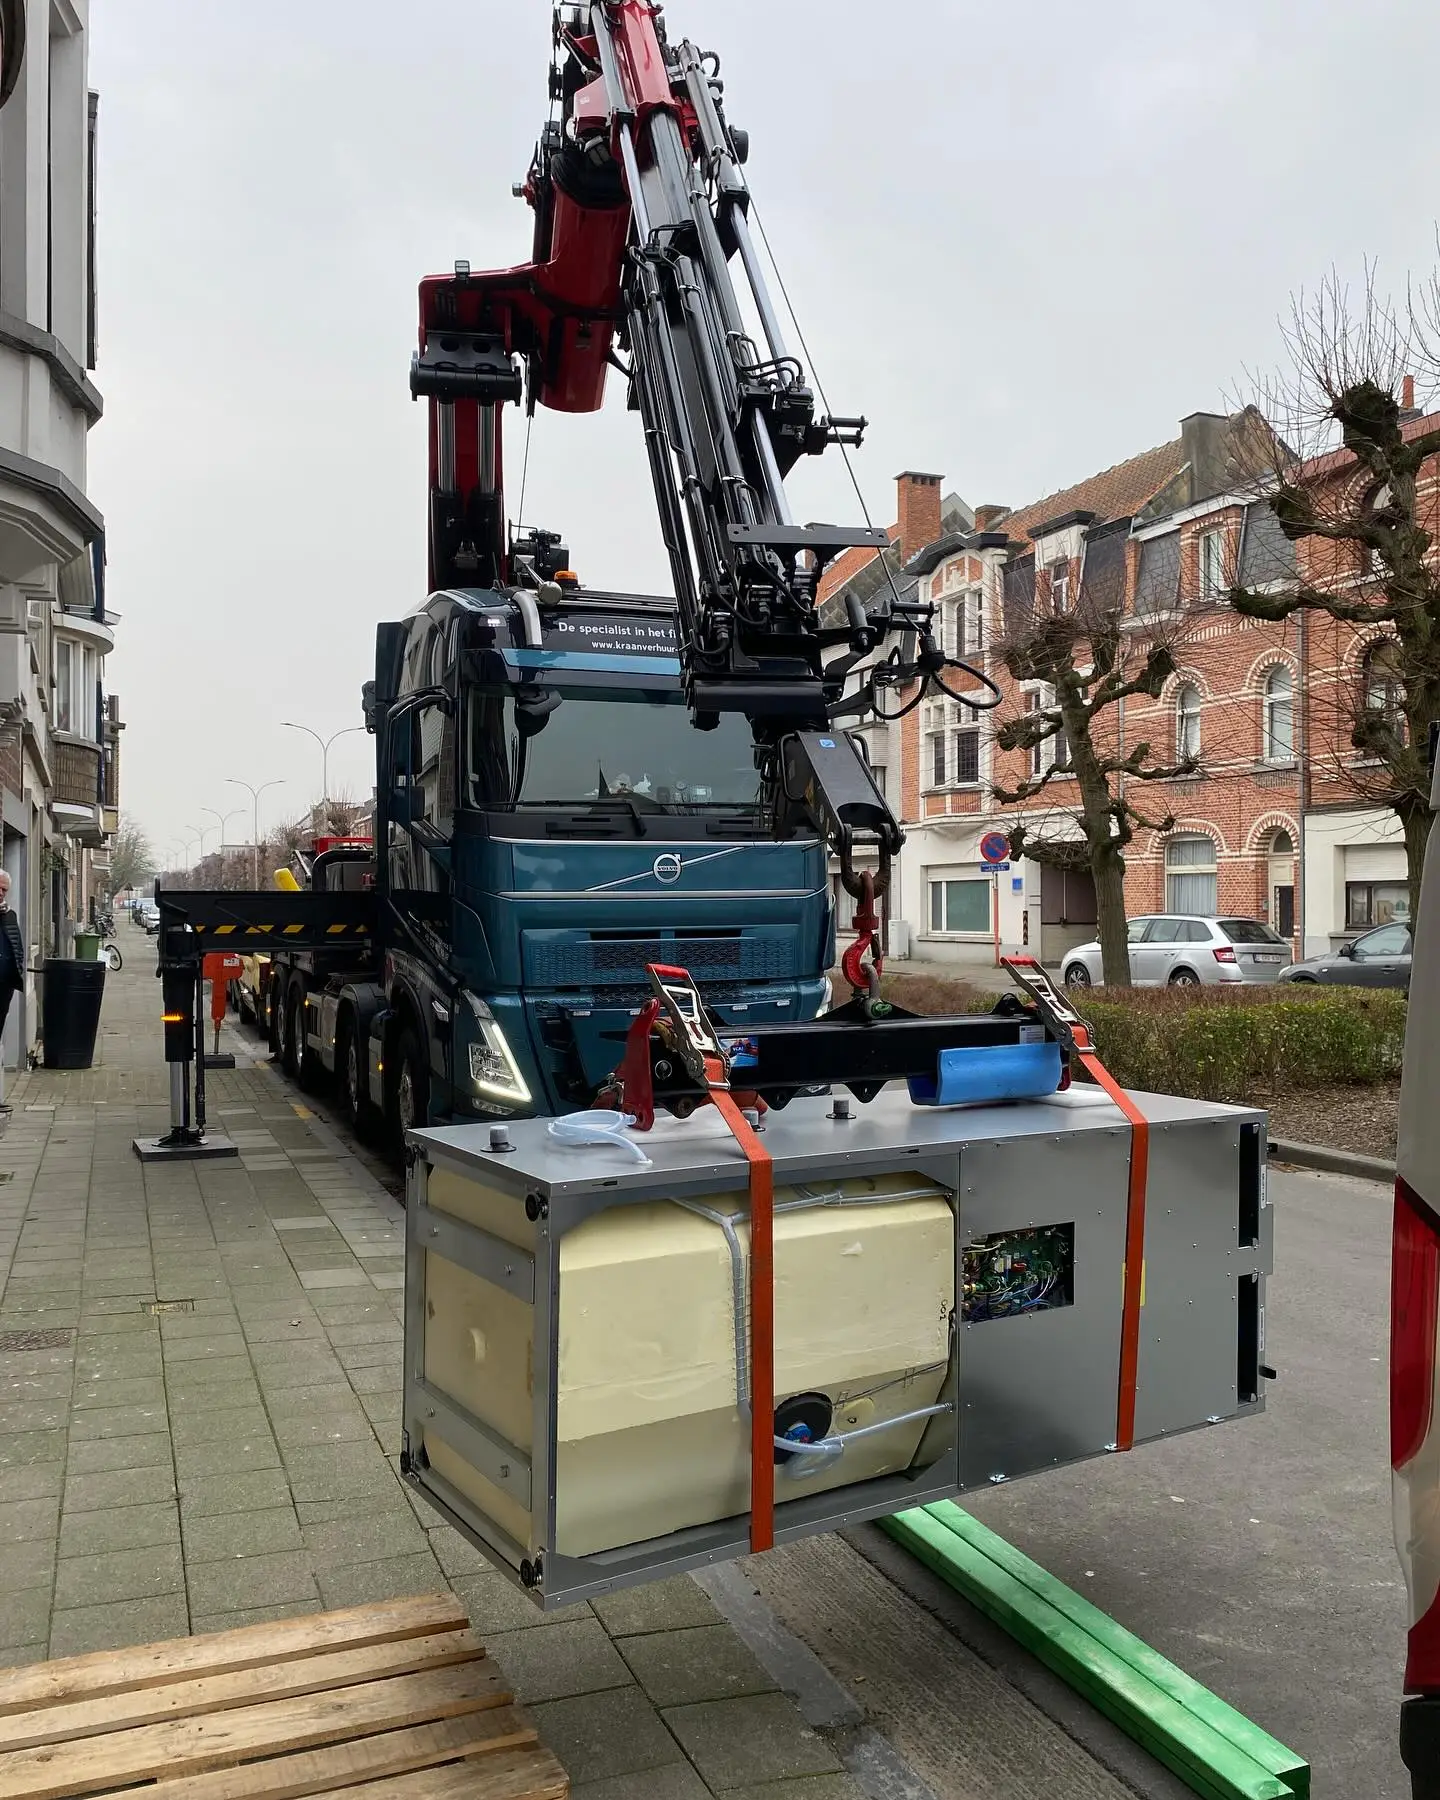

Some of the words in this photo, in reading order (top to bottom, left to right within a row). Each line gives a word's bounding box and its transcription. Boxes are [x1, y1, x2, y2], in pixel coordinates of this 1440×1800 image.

[558, 621, 576, 632] De
[579, 624, 632, 636] specialist
[634, 627, 645, 636] in
[648, 627, 666, 638] het
[668, 629, 677, 639] fi
[591, 640, 679, 653] www.kraanverhuur-
